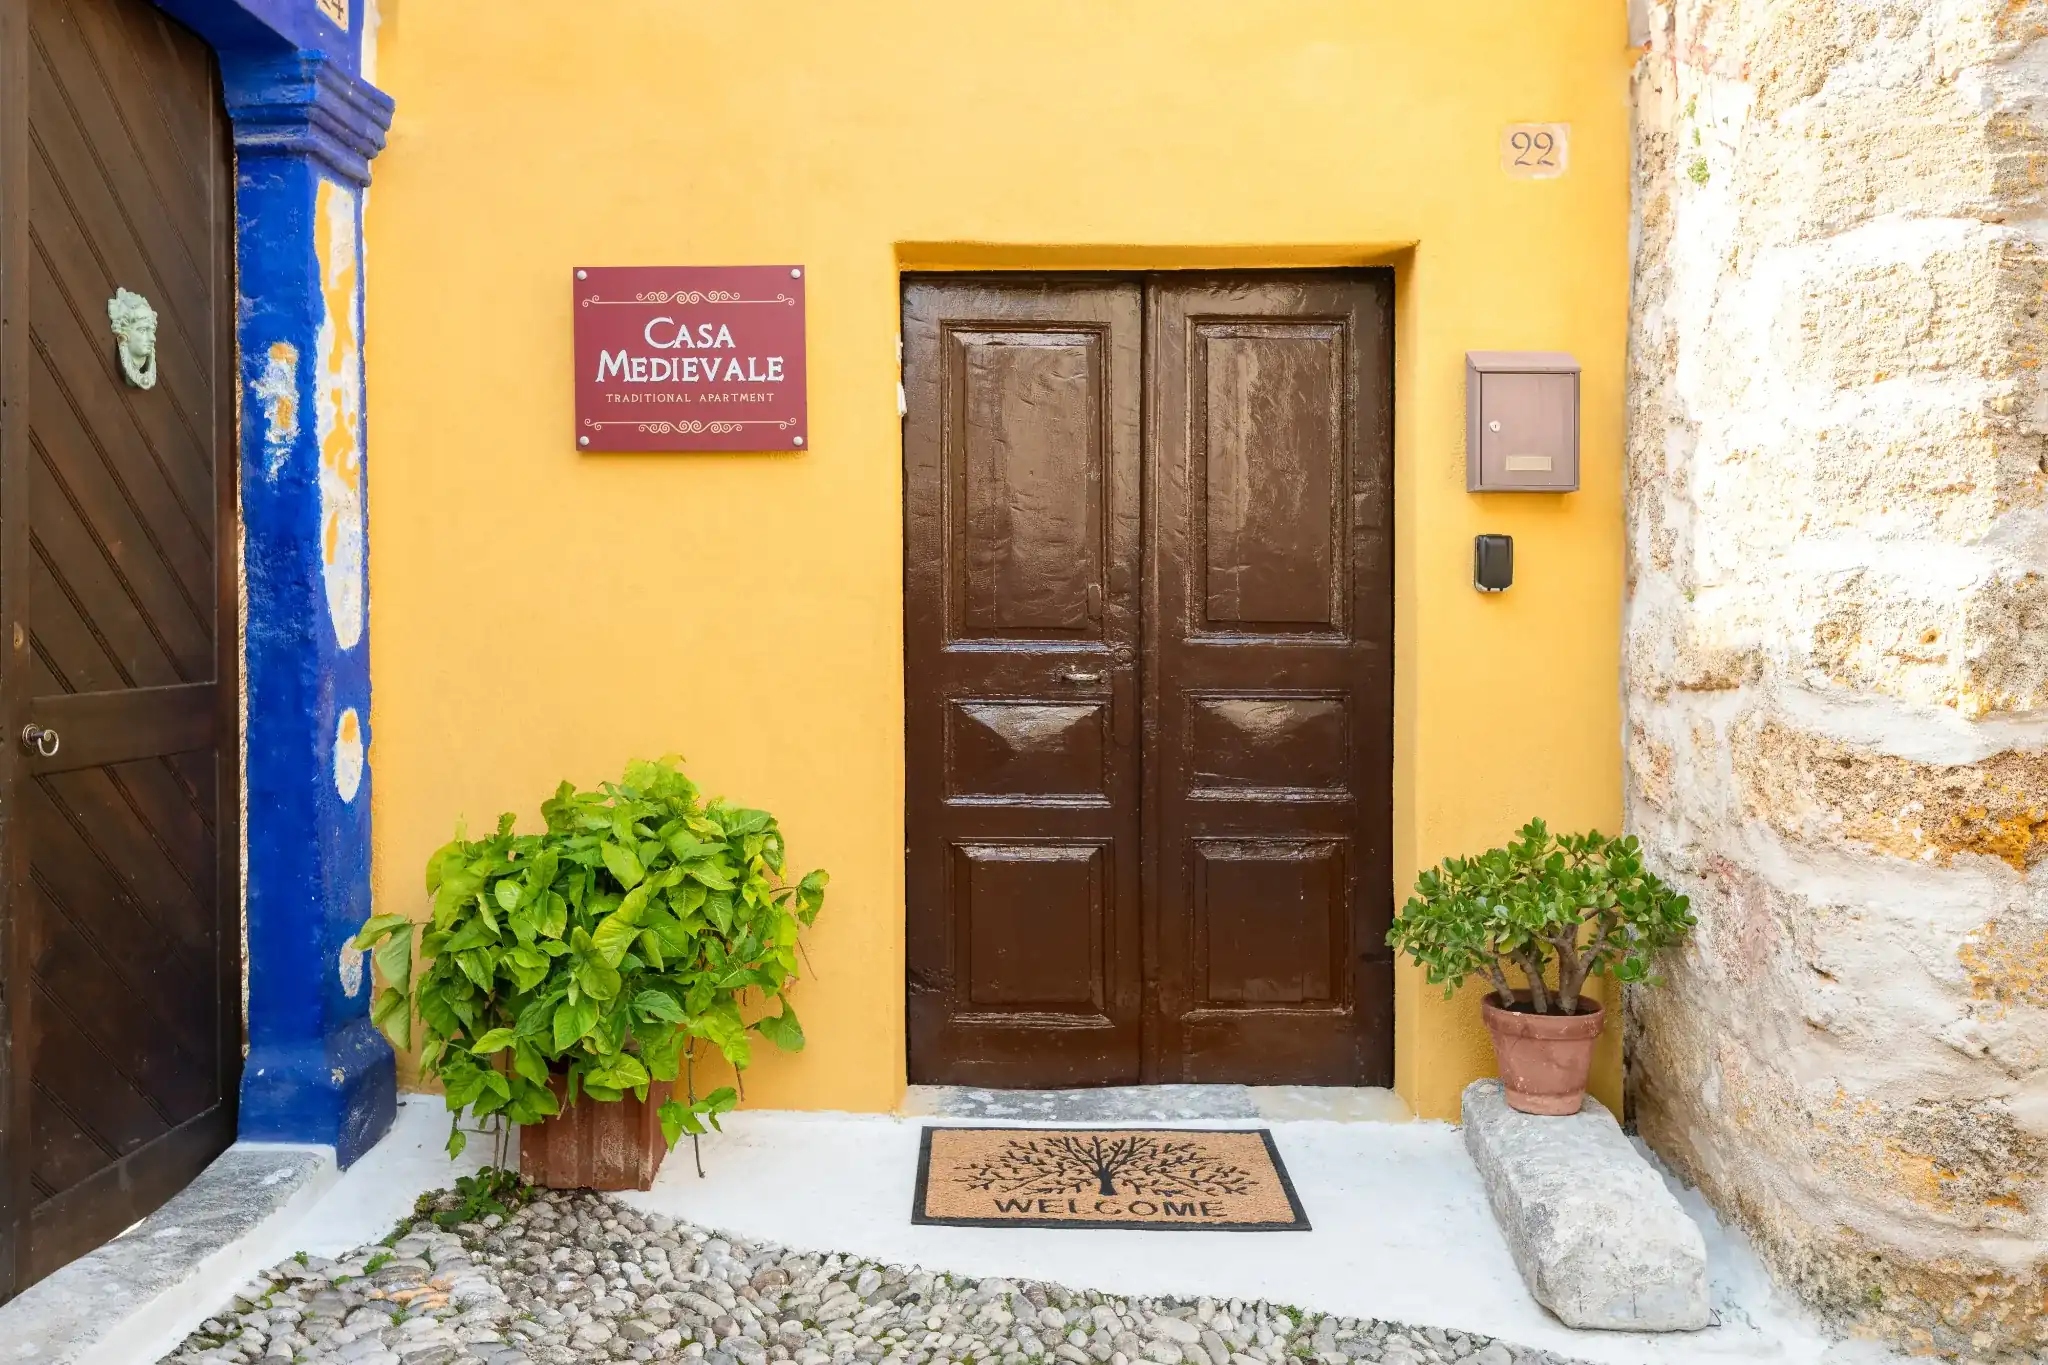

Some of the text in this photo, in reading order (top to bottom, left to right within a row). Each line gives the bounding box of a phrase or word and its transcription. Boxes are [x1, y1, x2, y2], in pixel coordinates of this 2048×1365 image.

[1511, 131, 1554, 166] 22
[644, 316, 736, 349] CASA
[595, 349, 785, 383] MEDIEVALE
[606, 392, 775, 403] TRADITIONAL APARTMENT
[993, 1198, 1228, 1218] WELCOME
